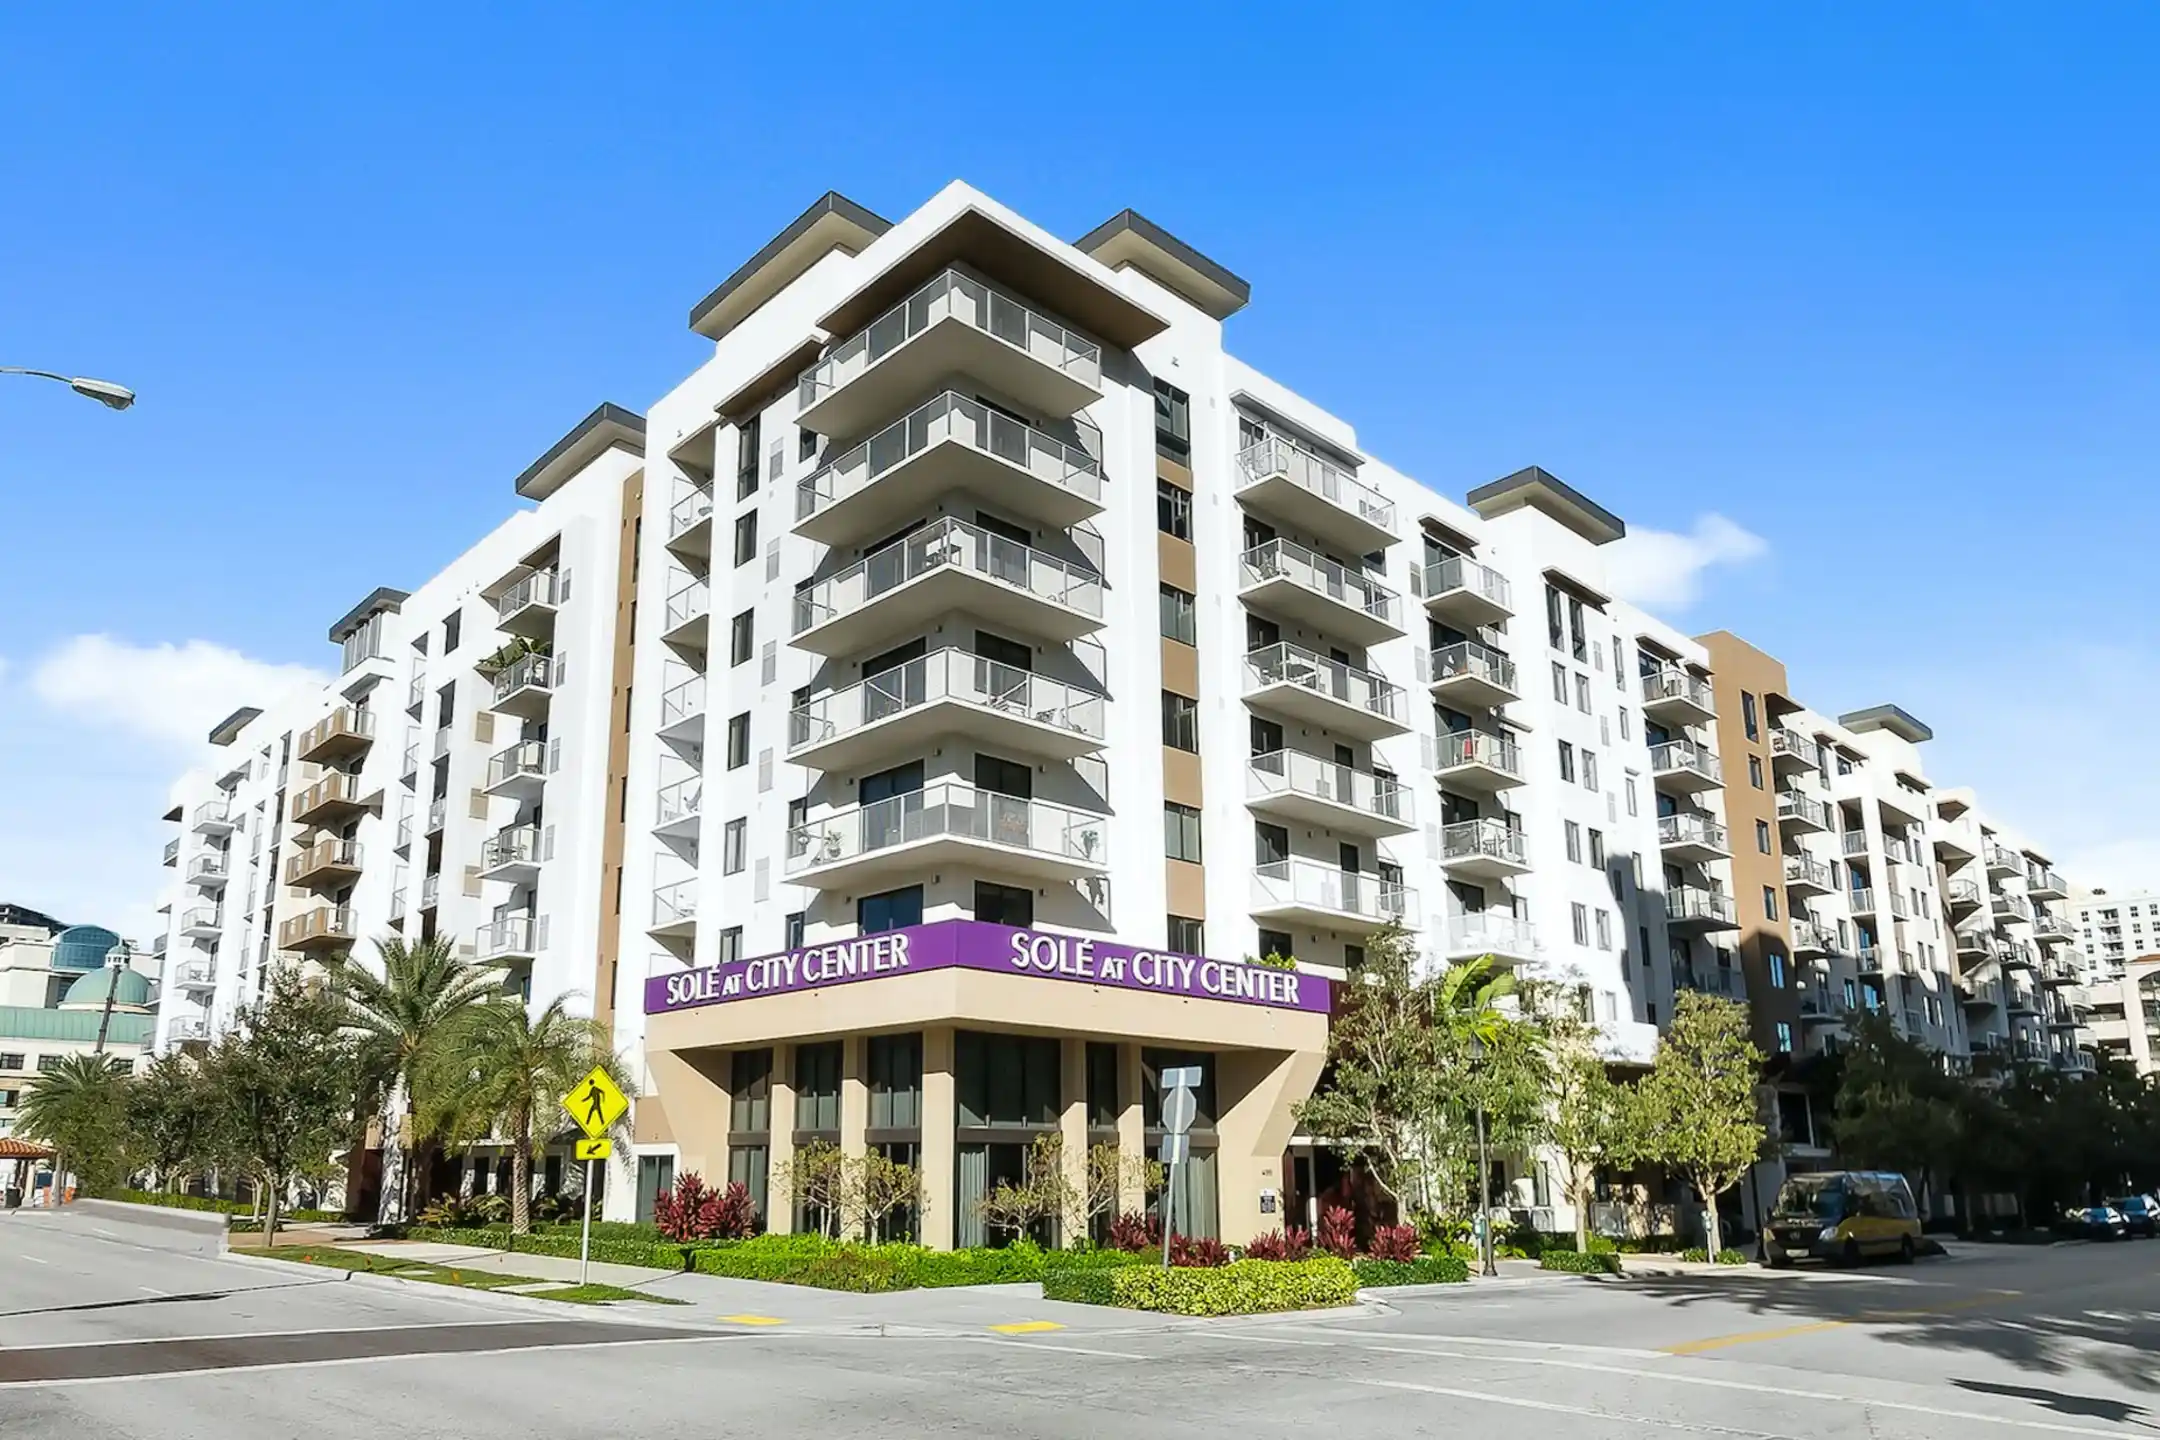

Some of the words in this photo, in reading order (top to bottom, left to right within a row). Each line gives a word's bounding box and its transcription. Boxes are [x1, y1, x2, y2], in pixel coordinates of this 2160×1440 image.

[666, 964, 720, 1006] SOLÉ
[722, 973, 743, 996] AT
[746, 952, 800, 992] CITY
[802, 933, 909, 983] CENTER
[1010, 932, 1095, 978] SOLÉ
[1100, 957, 1126, 981] AT
[1132, 951, 1196, 990] CITY
[1200, 961, 1300, 1004] CENTER
